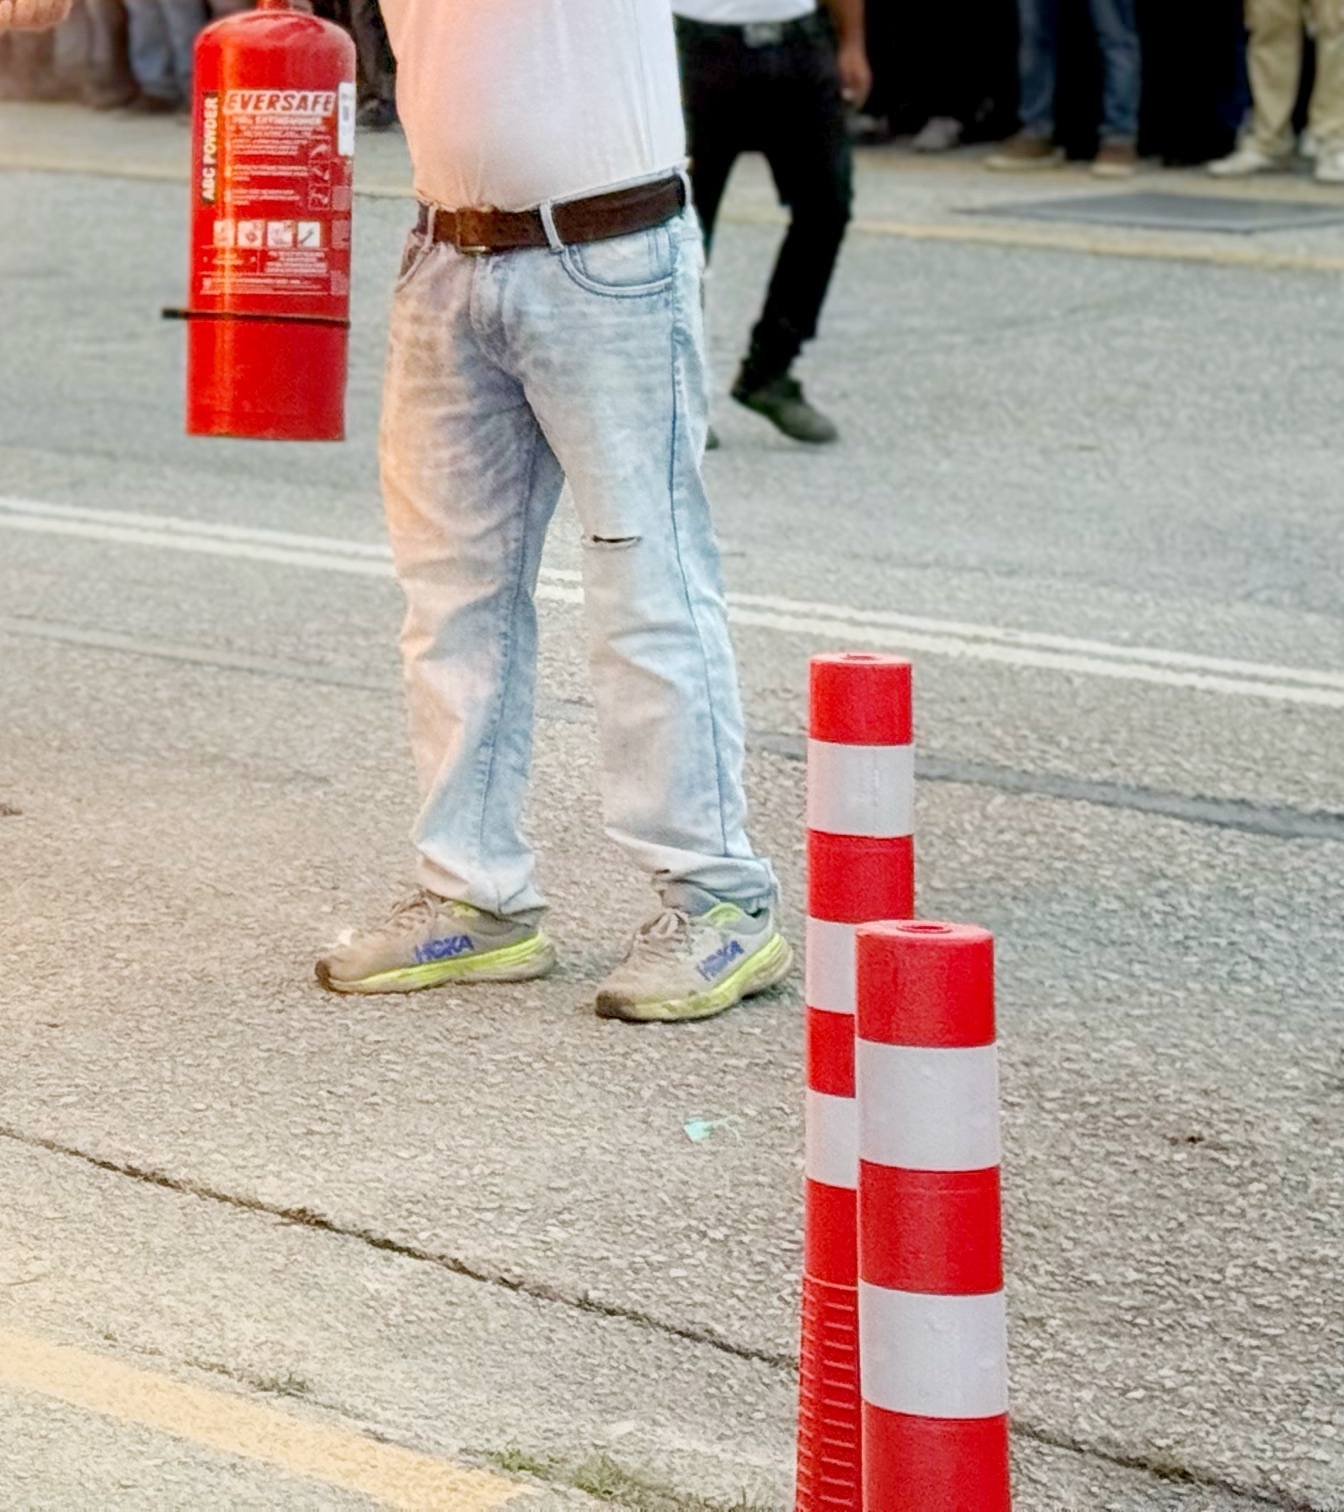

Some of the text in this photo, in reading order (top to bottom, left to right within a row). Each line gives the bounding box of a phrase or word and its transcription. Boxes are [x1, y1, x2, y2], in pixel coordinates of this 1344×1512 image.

[226, 91, 333, 113] EVERSAFE
[201, 97, 218, 201] ABC POWDER
